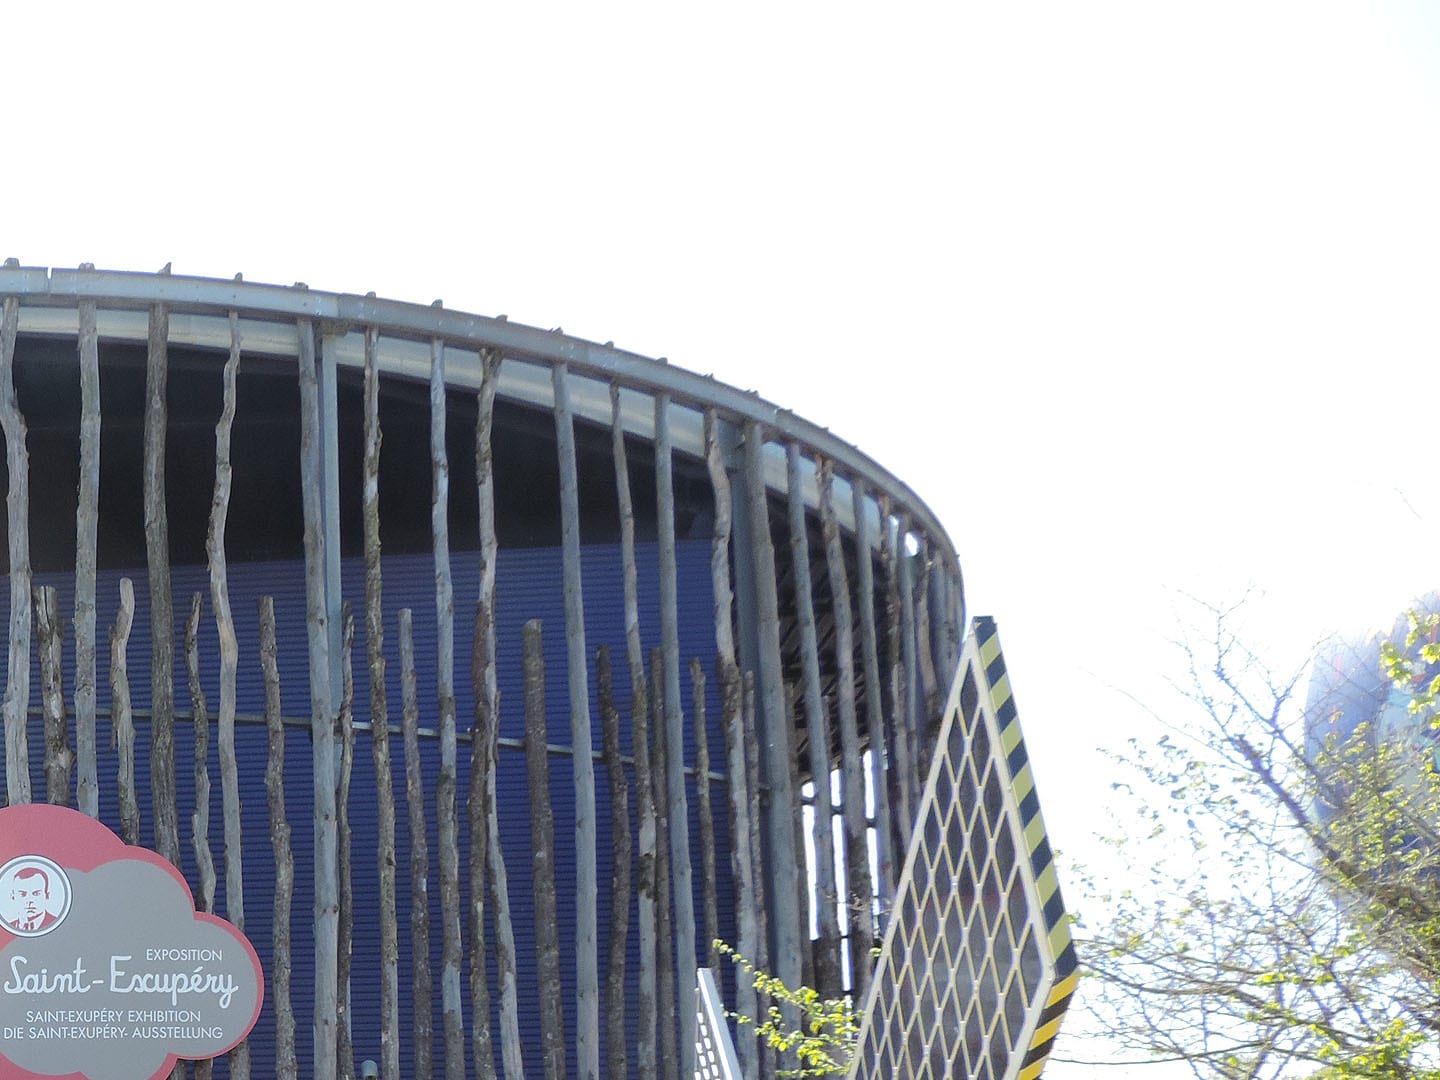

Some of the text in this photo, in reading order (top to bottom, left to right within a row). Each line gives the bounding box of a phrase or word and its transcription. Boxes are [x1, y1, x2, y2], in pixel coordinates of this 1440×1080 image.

[146, 949, 223, 961] EXPOSITION
[26, 1008, 201, 1023] SAINT-EXUPÉRY EXHIBITION
[3, 1024, 223, 1040] DIE SAINT-EXUPÉRY- AUSSTELLUNG
